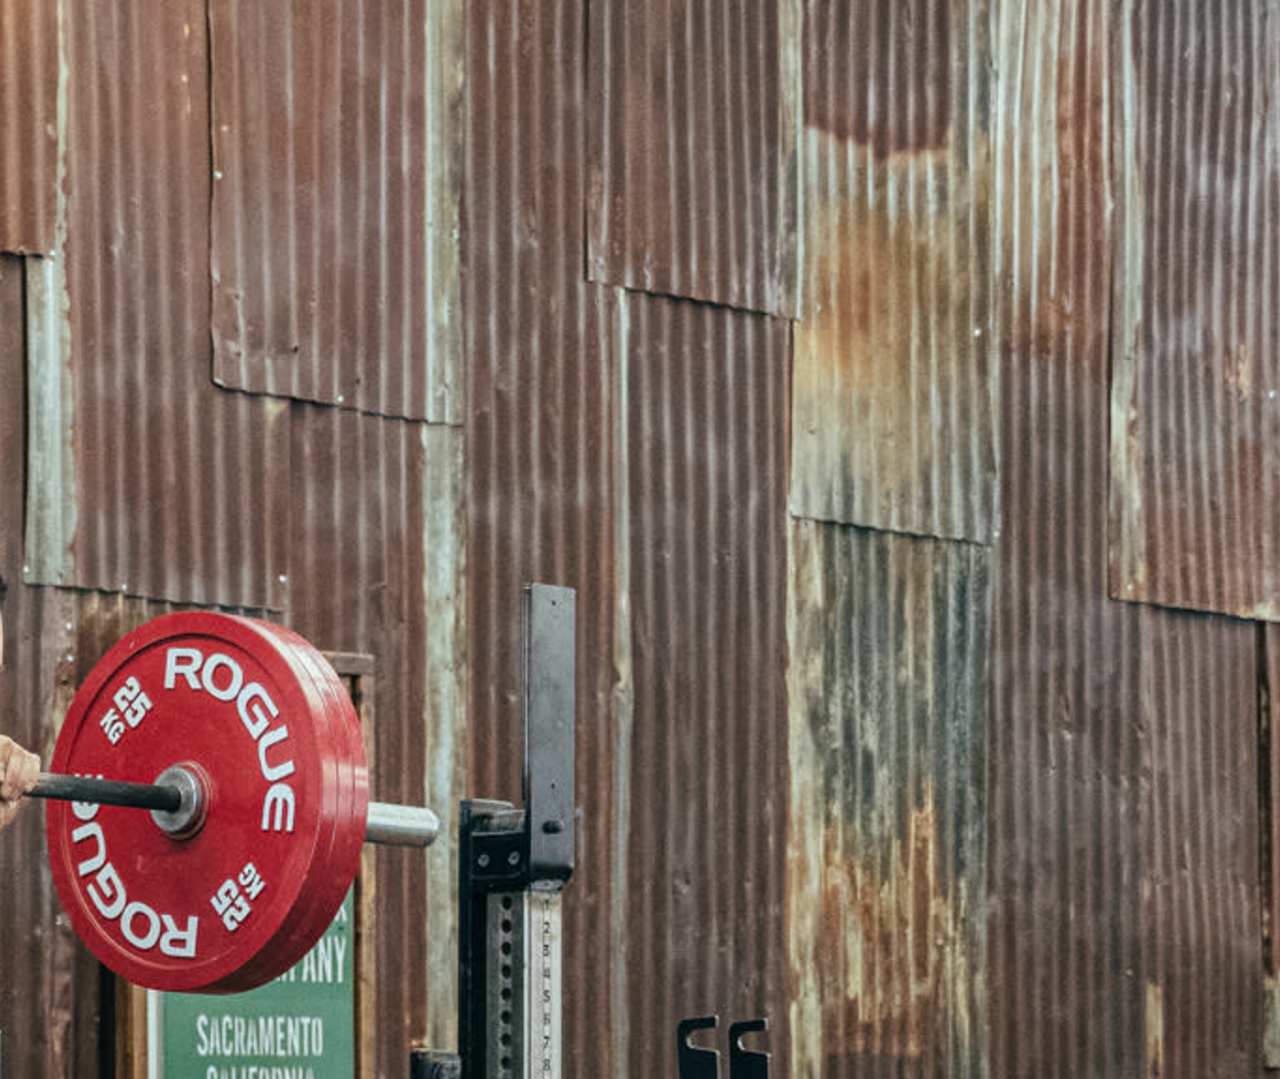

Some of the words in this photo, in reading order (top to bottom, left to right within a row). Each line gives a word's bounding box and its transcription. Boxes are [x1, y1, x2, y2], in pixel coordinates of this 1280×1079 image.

[113, 675, 153, 728] 25
[99, 711, 126, 746] KG
[164, 647, 297, 833] ROGUE
[238, 863, 266, 899] KG
[210, 879, 251, 932] 25
[196, 1014, 324, 1057] SACRAMENTO
